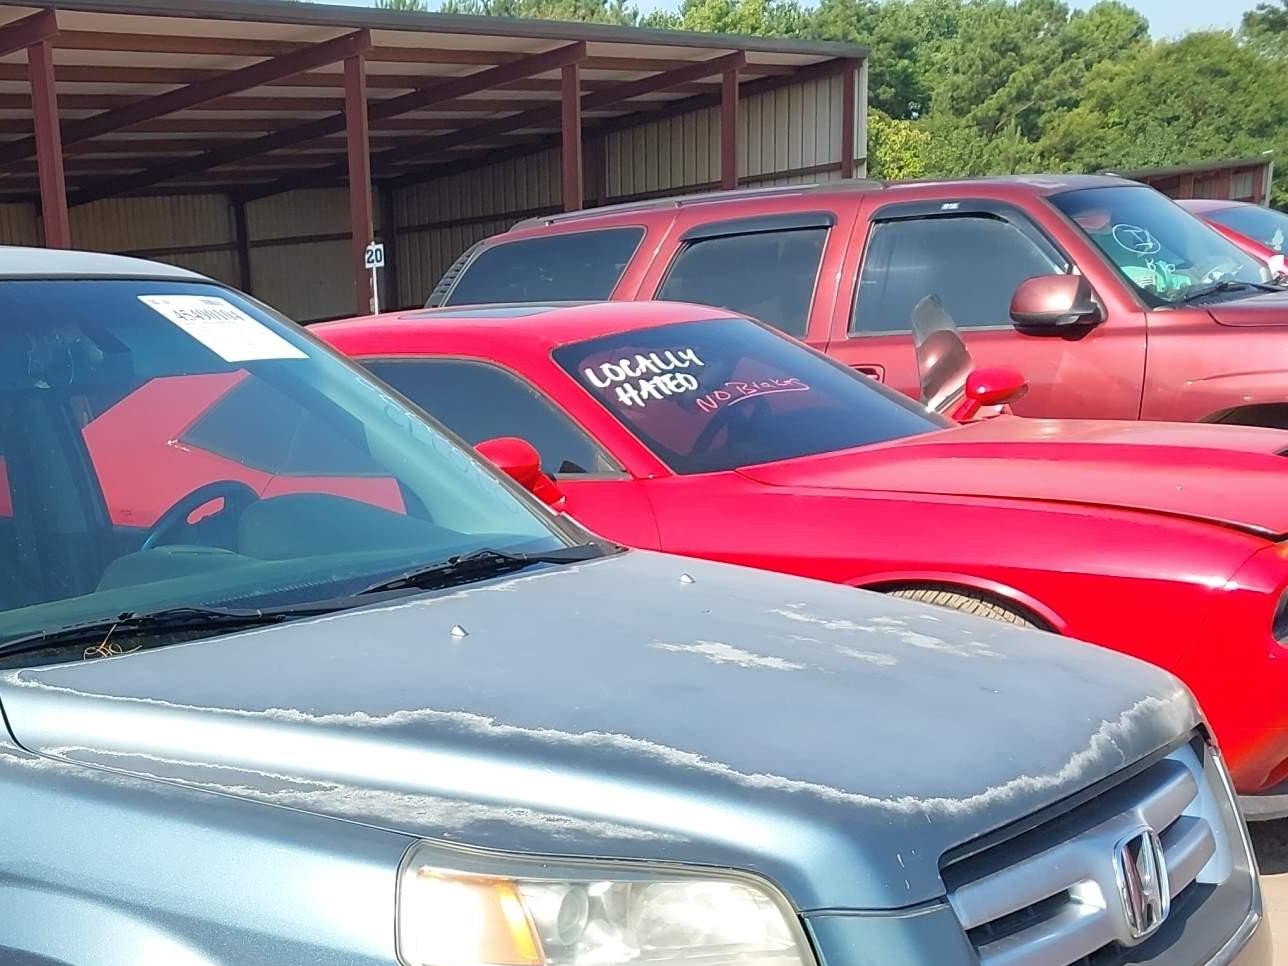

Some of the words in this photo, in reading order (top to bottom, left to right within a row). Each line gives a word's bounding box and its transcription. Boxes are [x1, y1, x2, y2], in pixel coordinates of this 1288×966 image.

[366, 248, 383, 264] 20
[584, 348, 705, 388] LOCALLY
[615, 372, 699, 407] HATED
